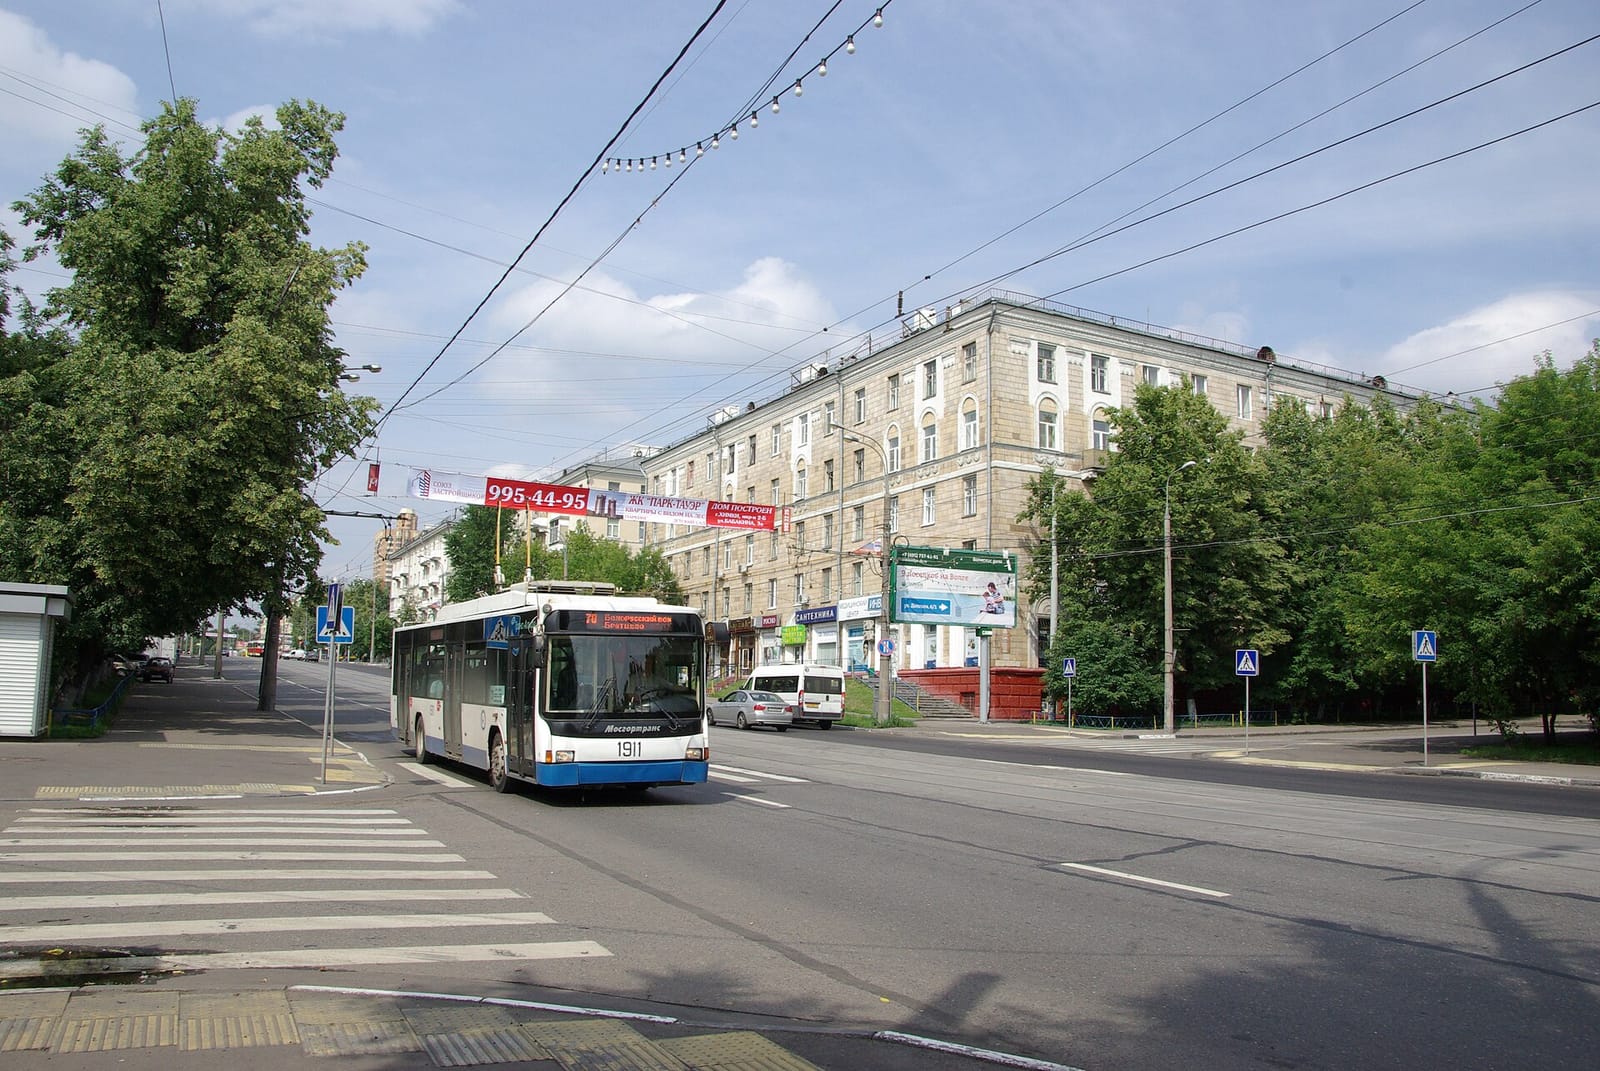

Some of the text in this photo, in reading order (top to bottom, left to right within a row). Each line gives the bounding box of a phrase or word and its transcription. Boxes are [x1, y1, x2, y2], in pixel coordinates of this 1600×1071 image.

[488, 485, 585, 510] 995-44-95
[628, 495, 645, 505] ЖК
[731, 504, 772, 514] ПОСТРОЕН
[585, 613, 598, 624] 70
[796, 609, 835, 622] САНТЕХНИКА
[604, 724, 661, 734] Мосгортранс
[617, 741, 642, 757] 1911
